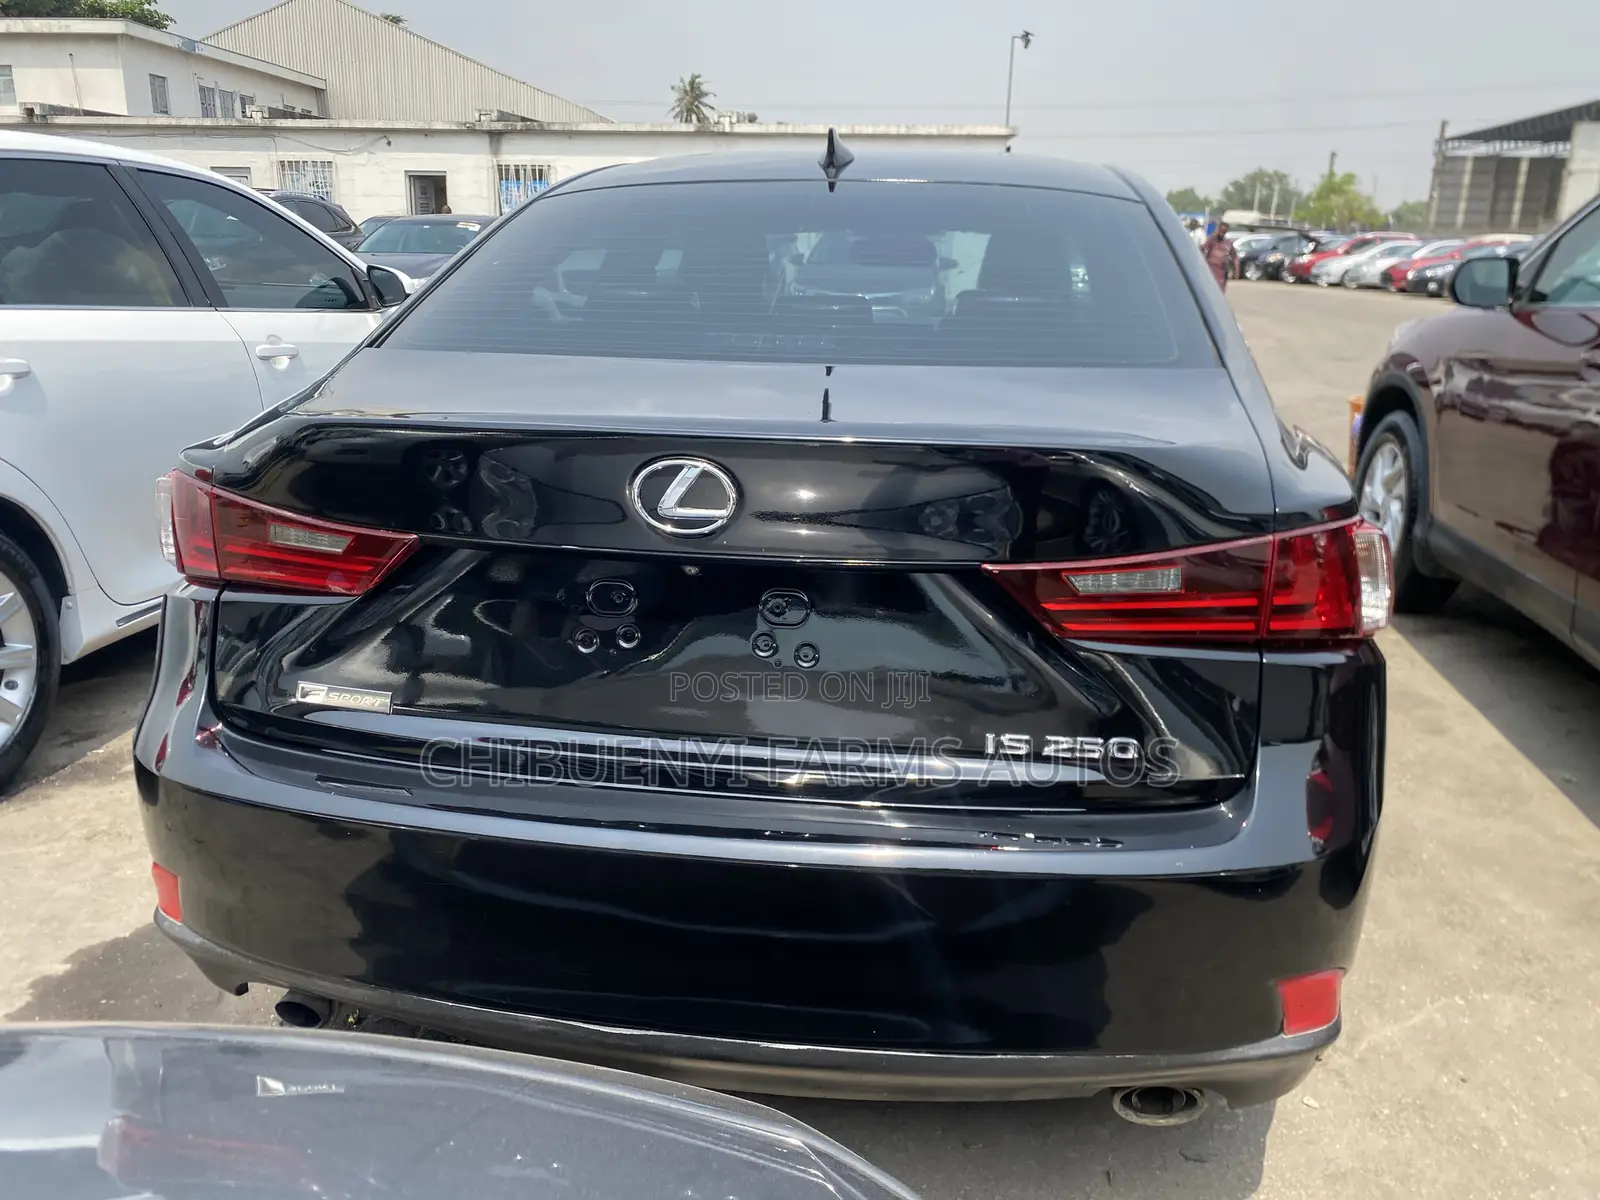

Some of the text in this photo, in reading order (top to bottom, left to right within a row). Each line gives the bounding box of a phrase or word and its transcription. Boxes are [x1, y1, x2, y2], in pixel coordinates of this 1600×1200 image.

[327, 692, 385, 708] SPORT
[985, 732, 1139, 759] IS 250
